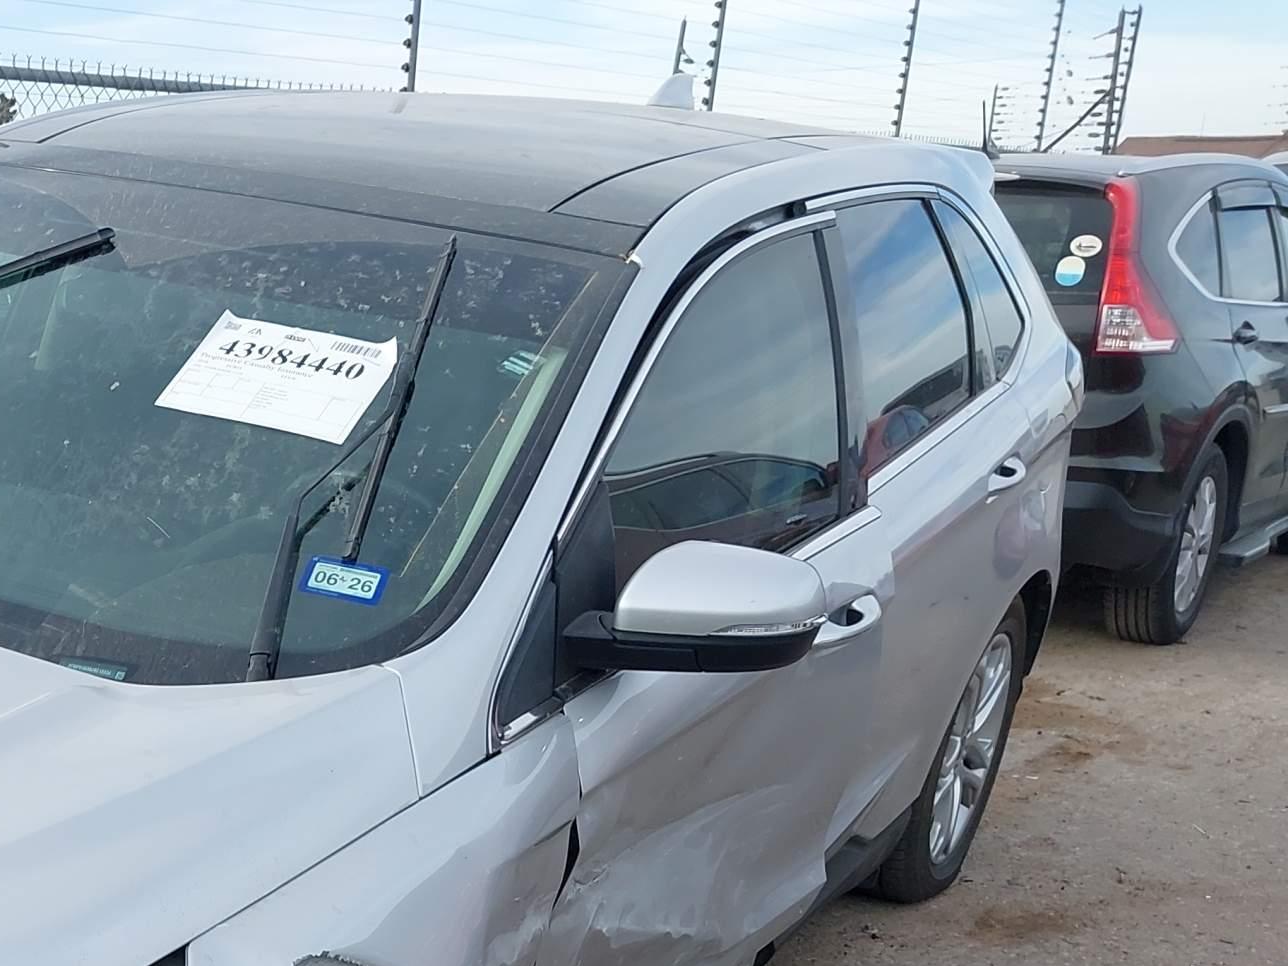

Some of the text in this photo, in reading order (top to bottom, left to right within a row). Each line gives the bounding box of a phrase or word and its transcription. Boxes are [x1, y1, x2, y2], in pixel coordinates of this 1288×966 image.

[219, 339, 366, 380] 43984440
[314, 570, 340, 586] 06
[347, 577, 374, 593] 26
